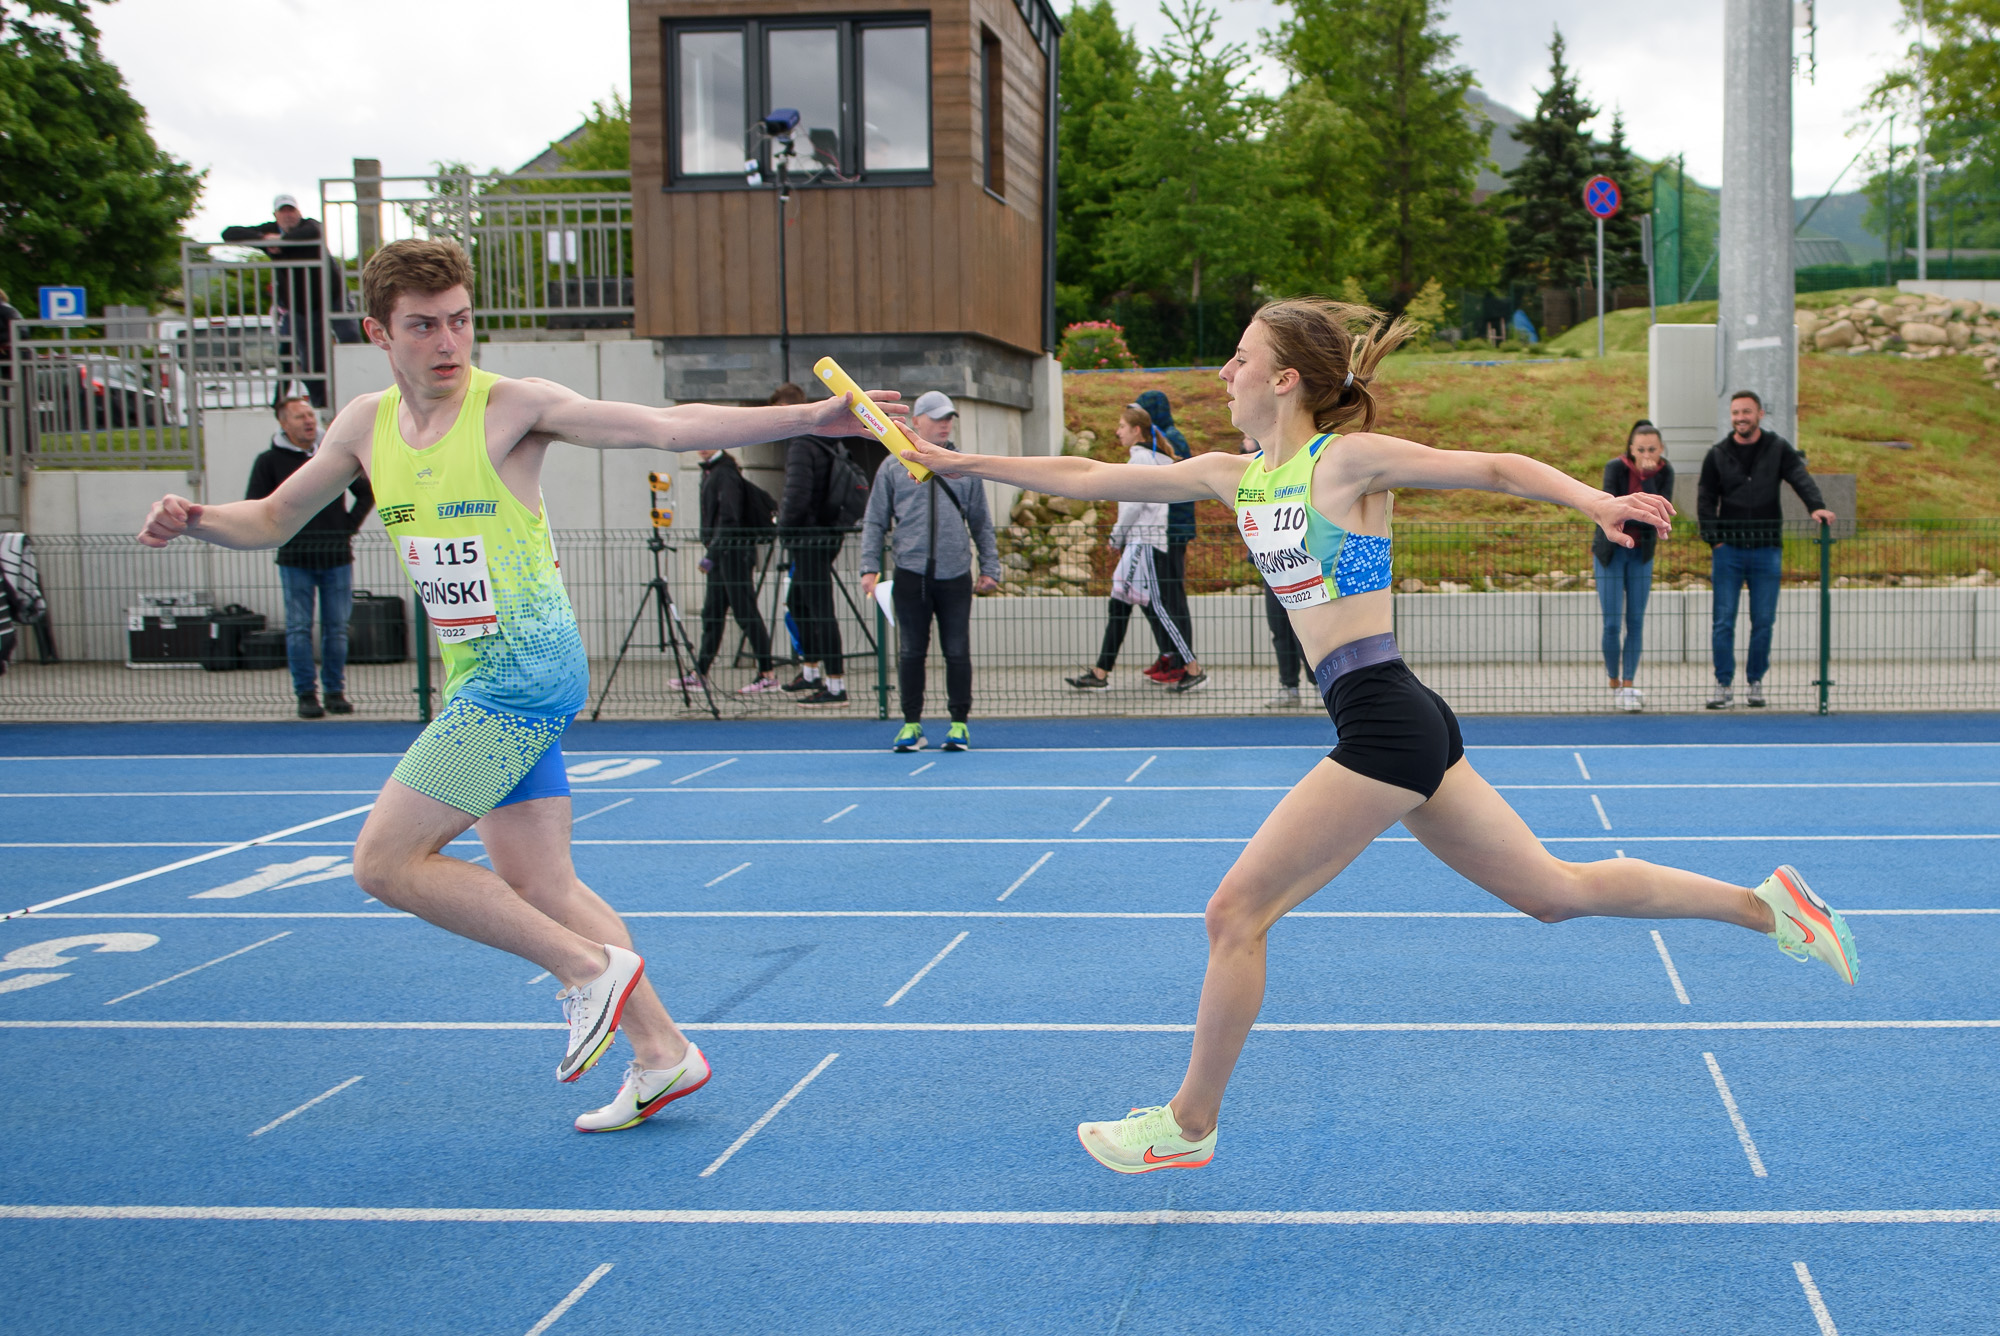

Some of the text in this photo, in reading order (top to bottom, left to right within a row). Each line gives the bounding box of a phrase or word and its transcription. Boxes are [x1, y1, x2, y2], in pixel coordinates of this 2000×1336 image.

[49, 291, 76, 320] P
[437, 500, 498, 519] SONAROL
[1273, 506, 1306, 531] 110
[433, 541, 478, 565] 115
[1293, 591, 1312, 603] 2022
[442, 628, 466, 637] 2022
[1321, 647, 1358, 680] SPORT
